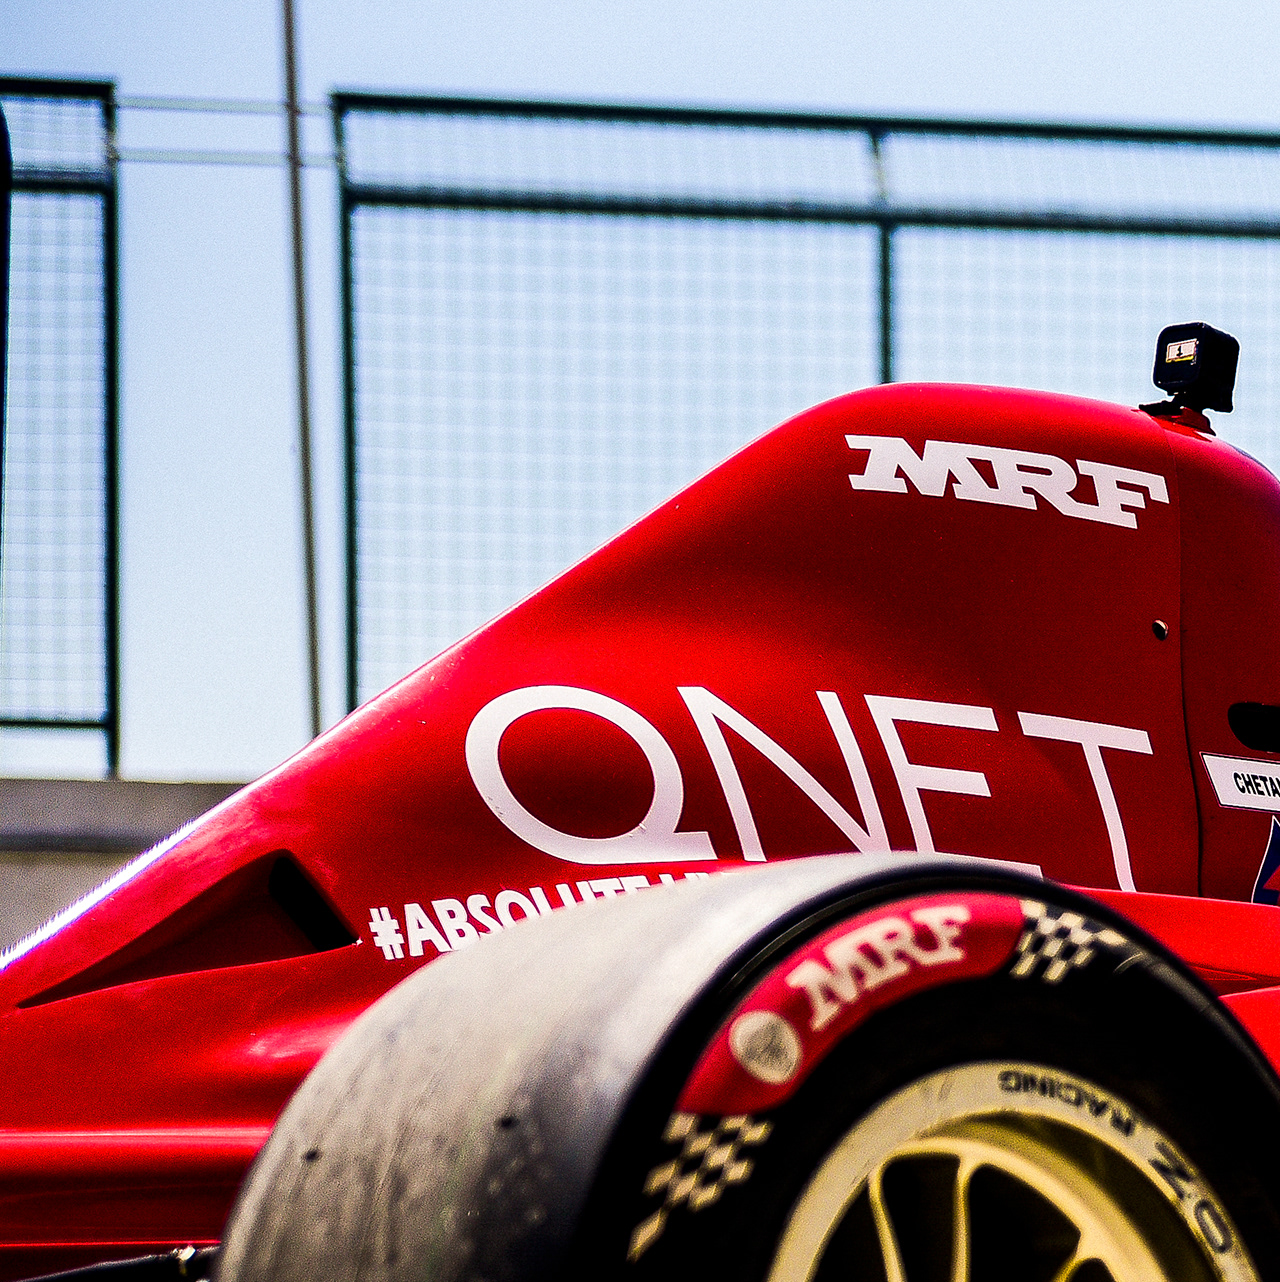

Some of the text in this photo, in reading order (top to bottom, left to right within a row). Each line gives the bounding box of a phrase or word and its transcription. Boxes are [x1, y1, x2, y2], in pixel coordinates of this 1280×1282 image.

[844, 434, 1170, 529] MRF
[465, 684, 1153, 893] QNET
[785, 904, 971, 1033] MRF
[997, 1069, 1137, 1138] RACING
